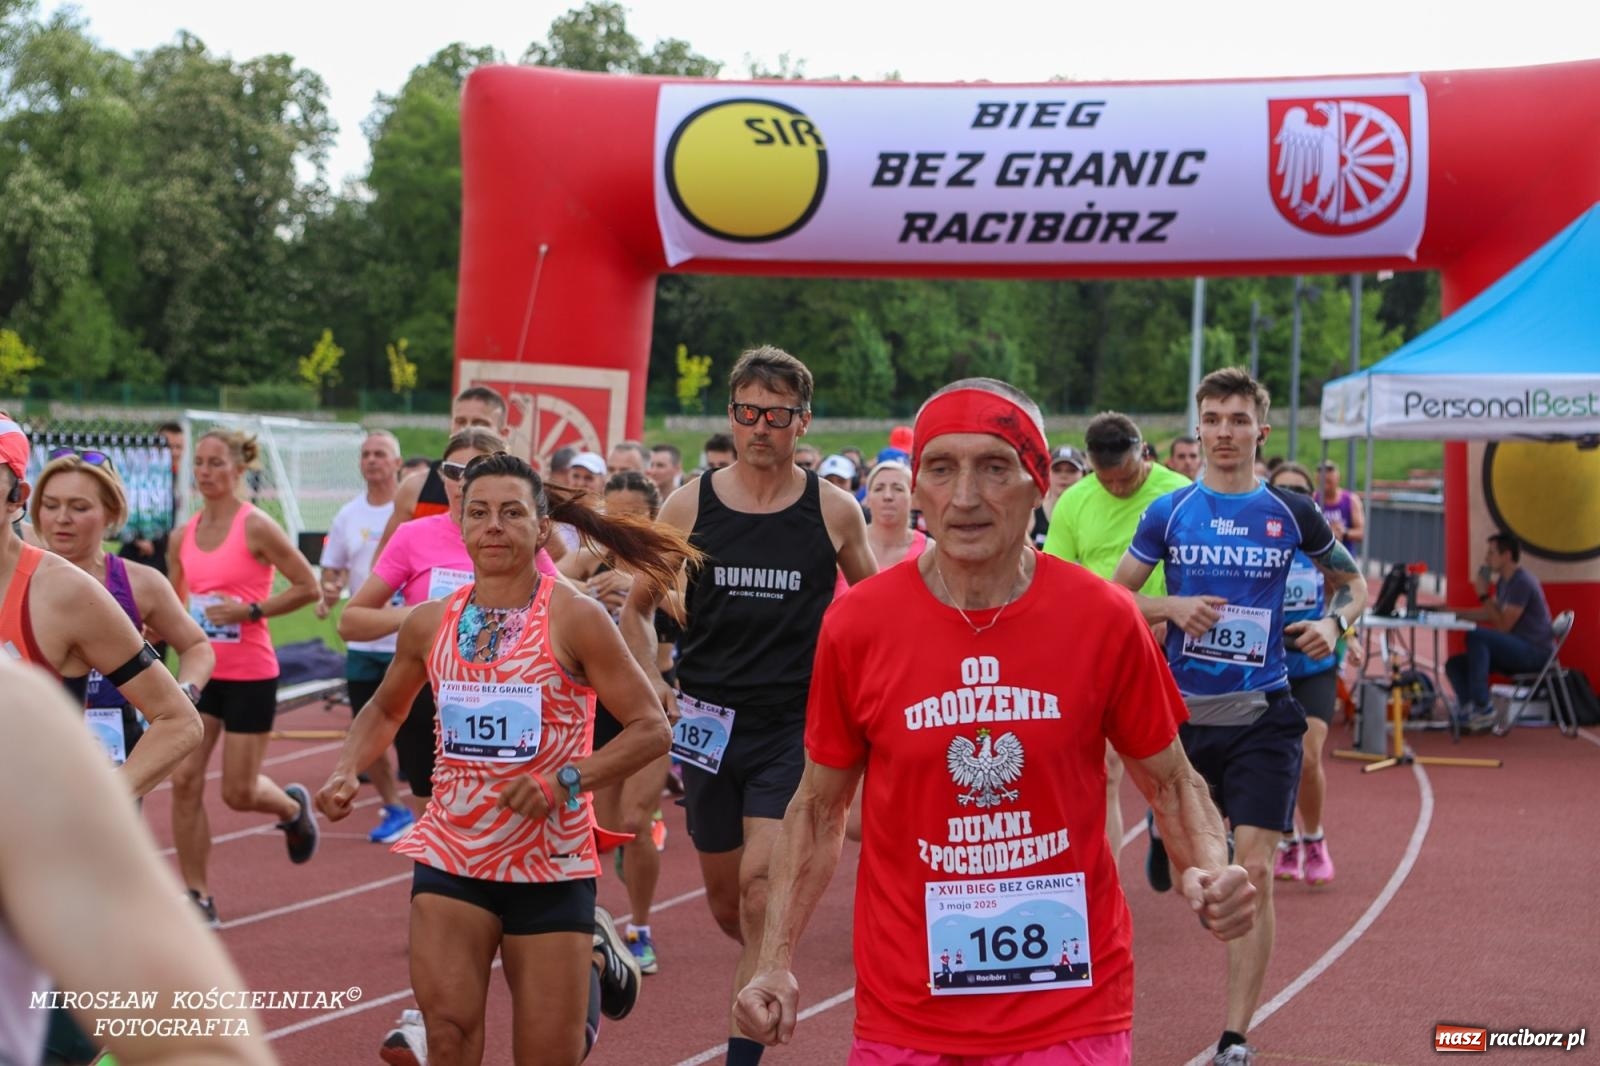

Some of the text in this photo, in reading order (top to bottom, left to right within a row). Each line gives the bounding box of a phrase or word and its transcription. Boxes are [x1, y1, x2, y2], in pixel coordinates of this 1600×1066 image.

[970, 101, 1107, 129] BIEG
[744, 117, 823, 147] SIR
[871, 149, 1206, 188] BEZ GRANIC
[1404, 388, 1600, 419] PersonalBest
[714, 566, 802, 591] RUNNING
[1244, 570, 1273, 579] TEAM
[1227, 606, 1240, 615] BEZ
[1208, 626, 1246, 649] 183
[961, 656, 1000, 686] OD
[446, 683, 533, 694] XVII BIEG BEZ GRANIC
[904, 686, 1061, 731] URODZENIA
[465, 714, 508, 741] 151
[680, 723, 713, 749] 187
[948, 811, 1032, 843] DUMNI
[938, 885, 963, 895] XVII
[966, 883, 996, 895] BIEG
[1000, 881, 1023, 892] BEZ
[1026, 877, 1074, 891] GRANIC
[939, 900, 997, 912] 3 maja 2025
[970, 923, 1049, 963] 168
